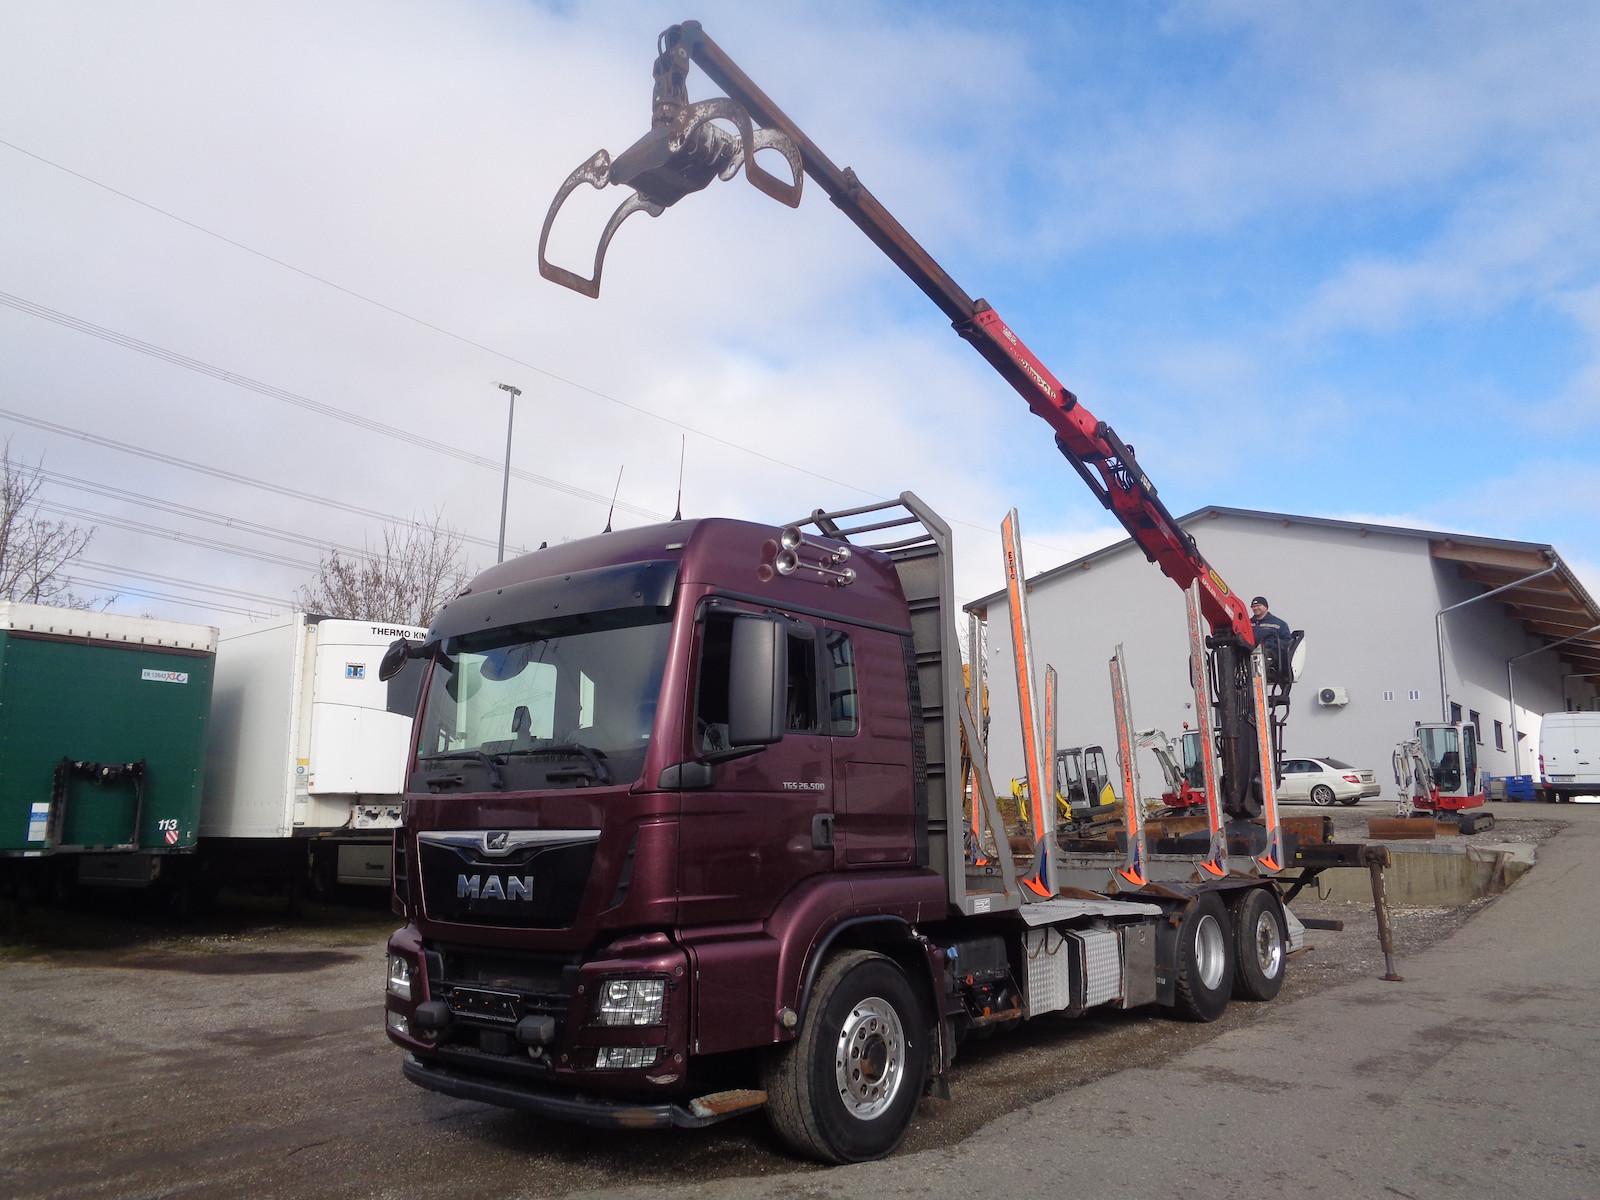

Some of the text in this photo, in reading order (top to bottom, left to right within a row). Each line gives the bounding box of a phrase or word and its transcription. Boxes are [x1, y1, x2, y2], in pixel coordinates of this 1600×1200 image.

[371, 627, 427, 641] THERMO KIN
[783, 781, 825, 790] TGS 26.500
[158, 818, 178, 831] 113
[457, 874, 534, 901] MAN
